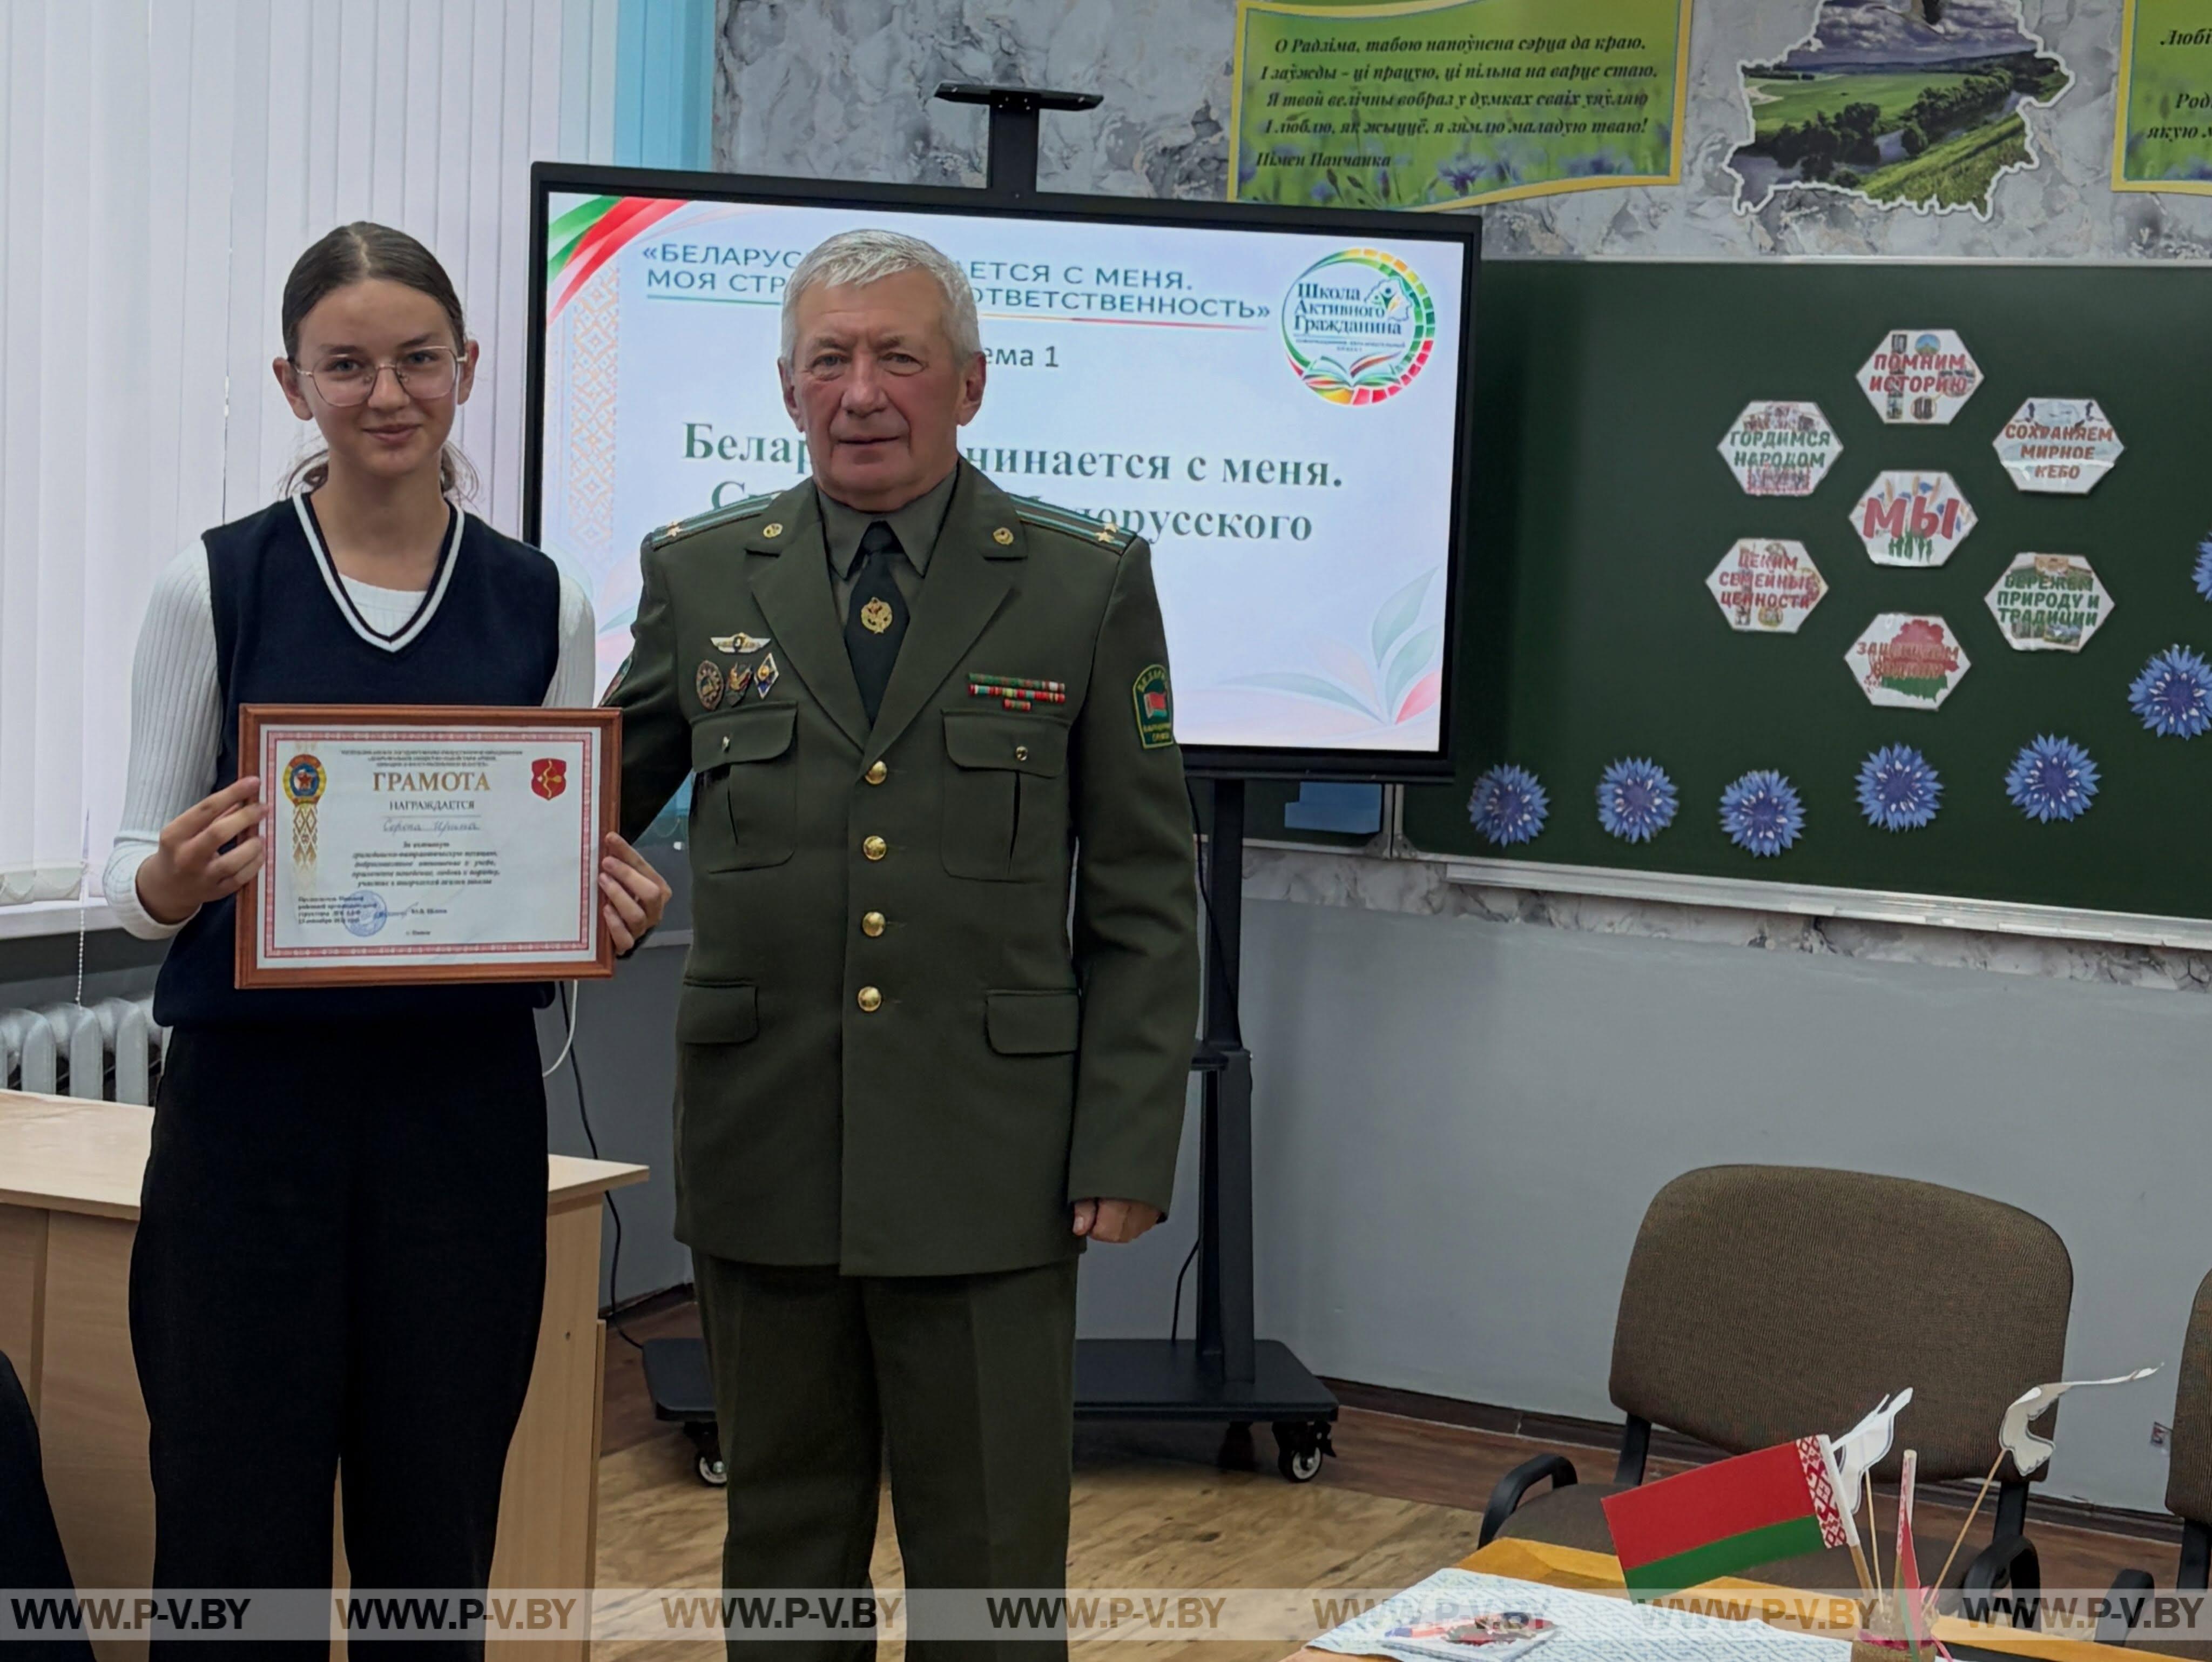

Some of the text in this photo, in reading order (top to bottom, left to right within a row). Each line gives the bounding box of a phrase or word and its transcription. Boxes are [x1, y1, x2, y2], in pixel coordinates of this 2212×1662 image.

[1275, 39, 1287, 53] О
[1292, 38, 1360, 53] Радзіма,
[1366, 36, 1422, 52] табою
[1518, 37, 1567, 53] сэрца
[1570, 35, 1590, 50] да
[1595, 36, 1645, 53] краю.
[1353, 64, 1370, 82] ці
[1373, 66, 1439, 82] працую,
[1445, 63, 1462, 82] ці
[1465, 62, 1521, 79] пільна
[1526, 66, 1546, 78] на
[1550, 64, 1600, 81] варце
[1604, 65, 1657, 79] стаю.
[1267, 92, 1279, 106] Я
[1283, 90, 1323, 106] твой
[1398, 91, 1454, 109] вобраз
[1455, 94, 1466, 110] у
[1470, 91, 1534, 110] думках
[1536, 90, 1582, 106] сваіх
[2176, 92, 2212, 109] Род
[1341, 122, 1360, 133] як
[1434, 123, 1444, 133] я
[1508, 118, 1587, 137] маладую
[1591, 118, 1648, 133] тваю!
[2147, 126, 2198, 142] якую
[1257, 152, 1392, 167] Пімен Панчанка
[643, 243, 801, 268] «БЕЛАРУС
[1064, 267, 1083, 284] С
[1096, 268, 1192, 290] МЕНЯ.
[648, 269, 716, 290] МОЯ
[729, 274, 786, 293] СТР
[1298, 283, 1360, 300] Школа
[1295, 299, 1385, 318] Активного
[1294, 315, 1401, 335] Гражданина
[984, 346, 1058, 367] ема 1
[1873, 353, 1966, 371] ПОМНИМ
[1869, 376, 1968, 393] ИСТОРИЮ
[1730, 430, 1831, 448] ГОРДИМСЯ
[2005, 423, 2114, 442] СОХРАНЯЕМ
[683, 422, 1342, 487] Белар чинается с меня.
[1734, 451, 1826, 468] НАРОДОМ
[2020, 445, 2095, 459] МИРНОЕ
[1863, 495, 1960, 540] МЫ
[1719, 570, 1817, 591] СЕМЕЙНЫЕ
[1721, 591, 1810, 609] ЦЕННОСТИ
[1997, 591, 2100, 611] ПРИРОДУ И
[1998, 608, 2098, 627] ТРАДИЦИИ
[373, 772, 491, 791] ГРАМОТА
[390, 800, 475, 811] НАГРАЖДАЕТСЯ
